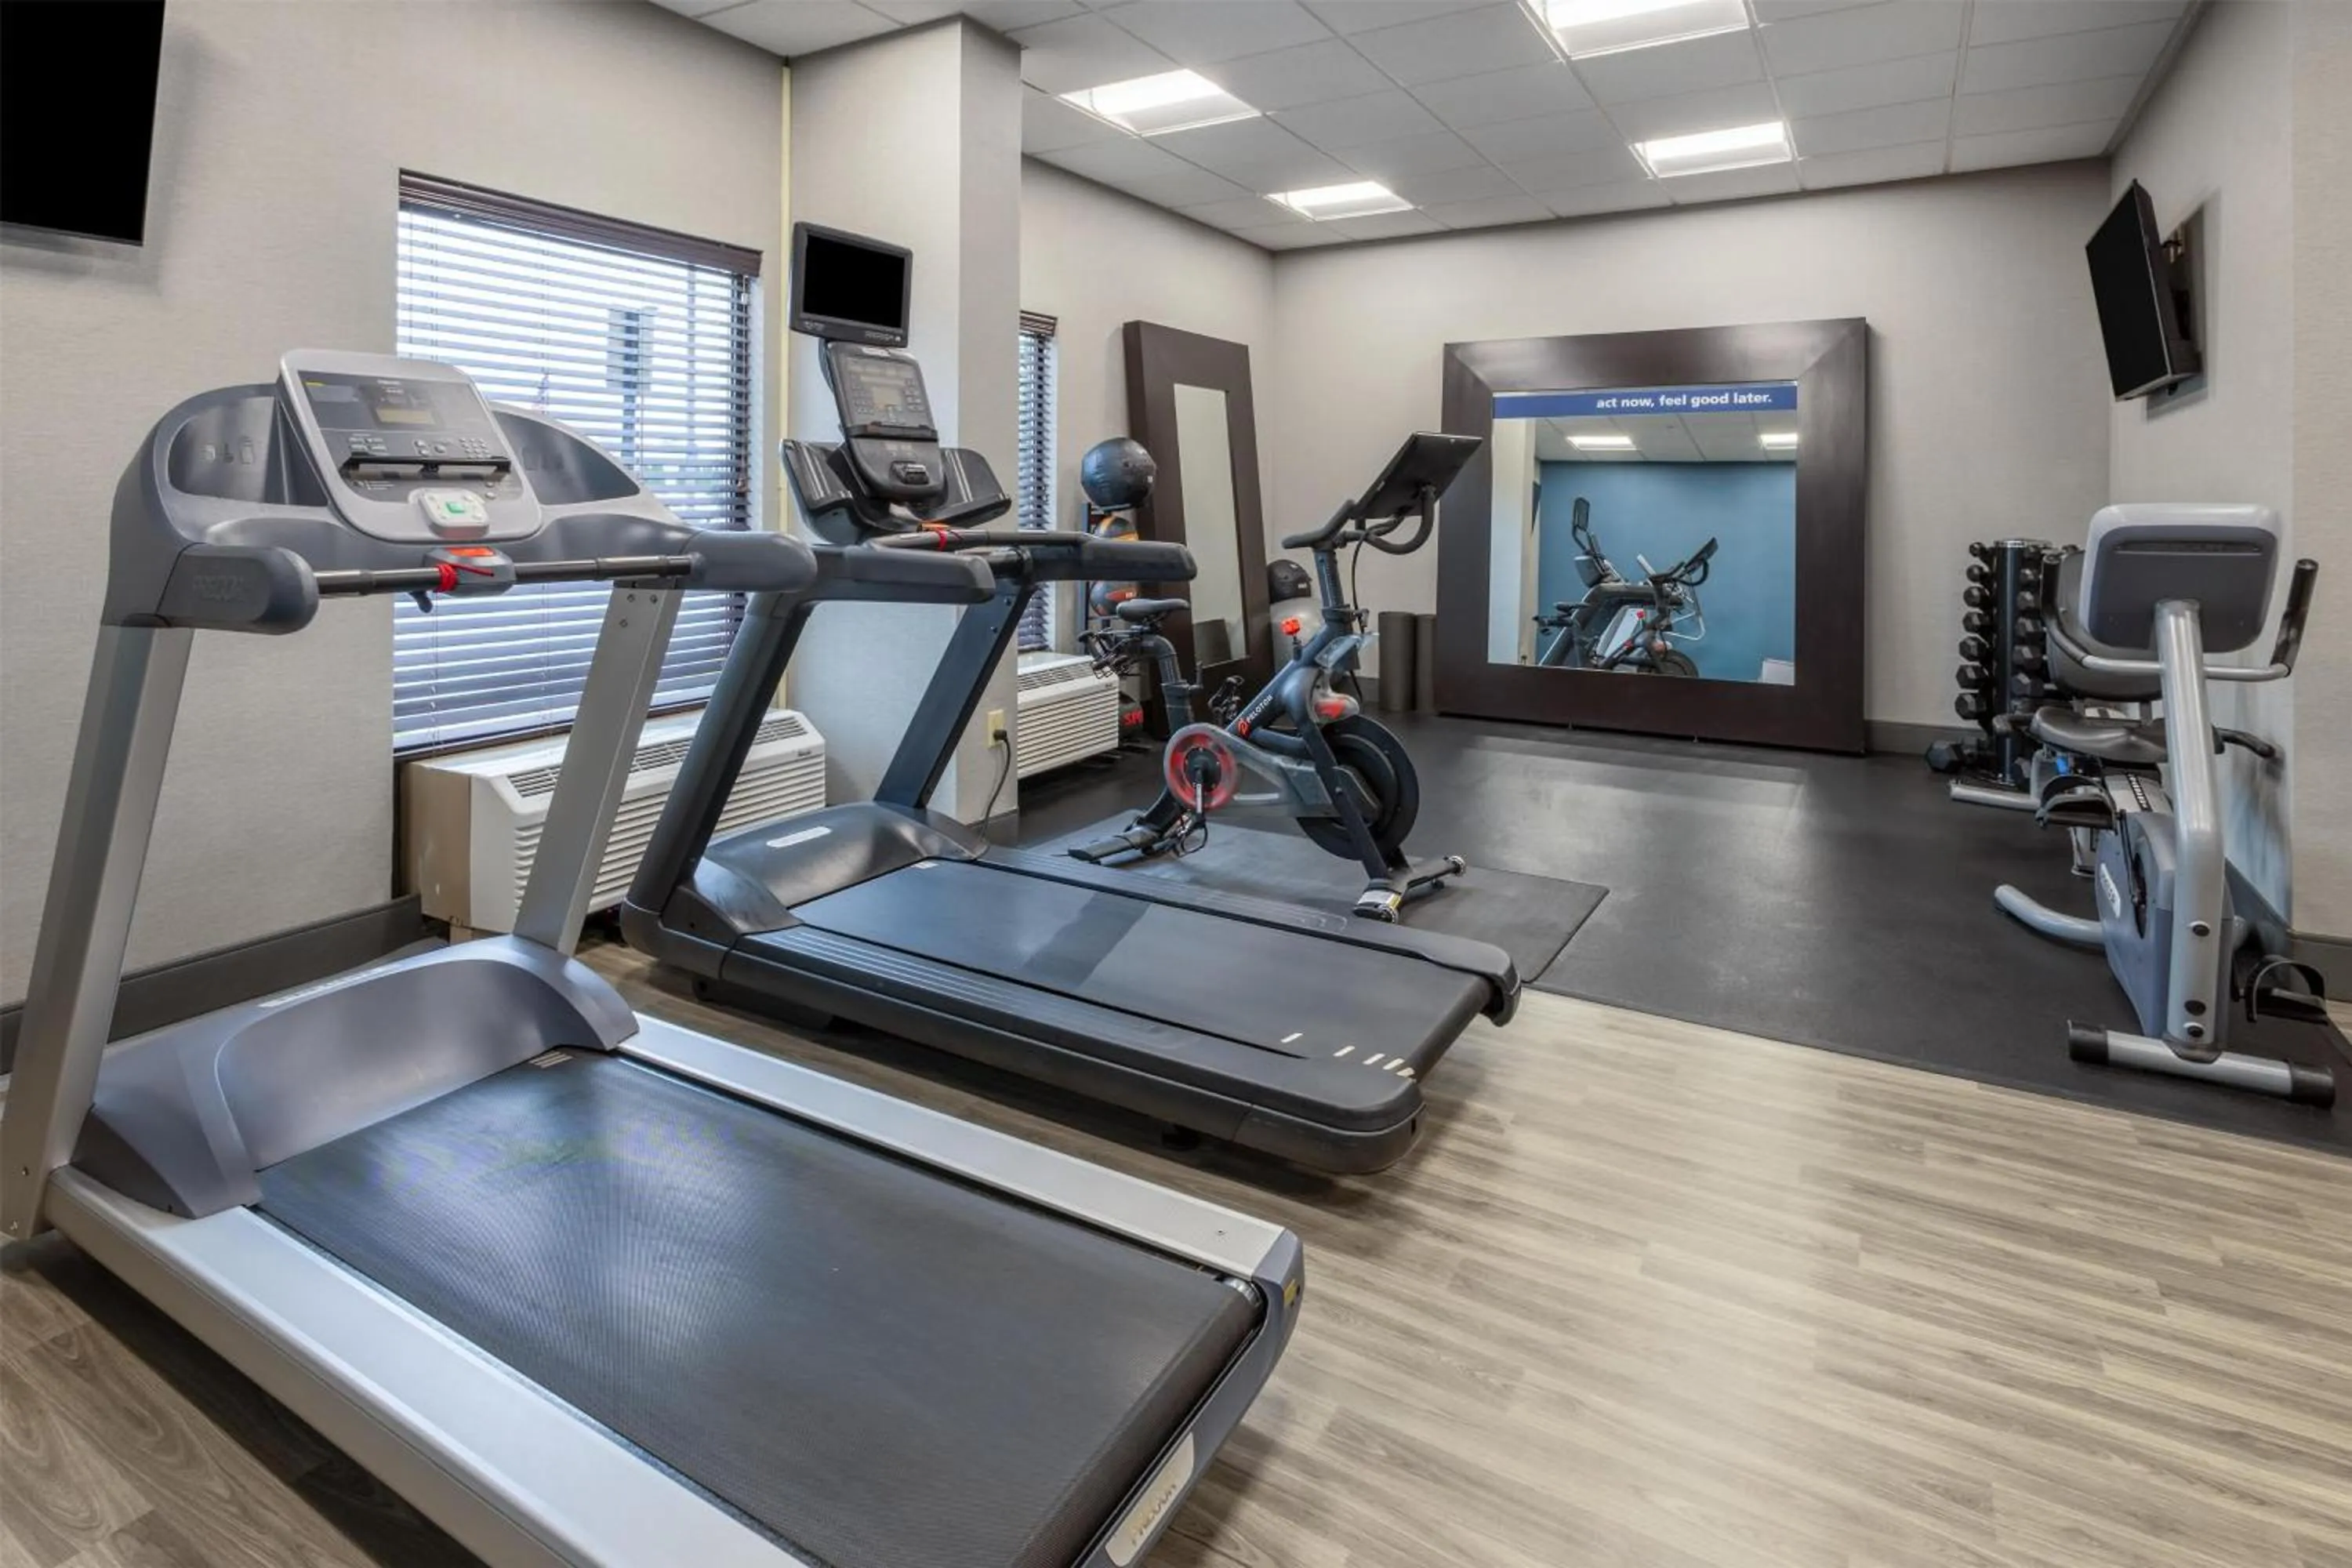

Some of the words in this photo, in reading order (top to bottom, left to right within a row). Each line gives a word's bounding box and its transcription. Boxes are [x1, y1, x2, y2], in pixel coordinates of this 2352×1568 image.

[1596, 397, 1617, 408] act
[1621, 396, 1655, 408] now,
[1659, 394, 1686, 407] feel
[1690, 393, 1729, 408] good
[1733, 393, 1773, 404] later.
[1245, 694, 1274, 723] PELOTON
